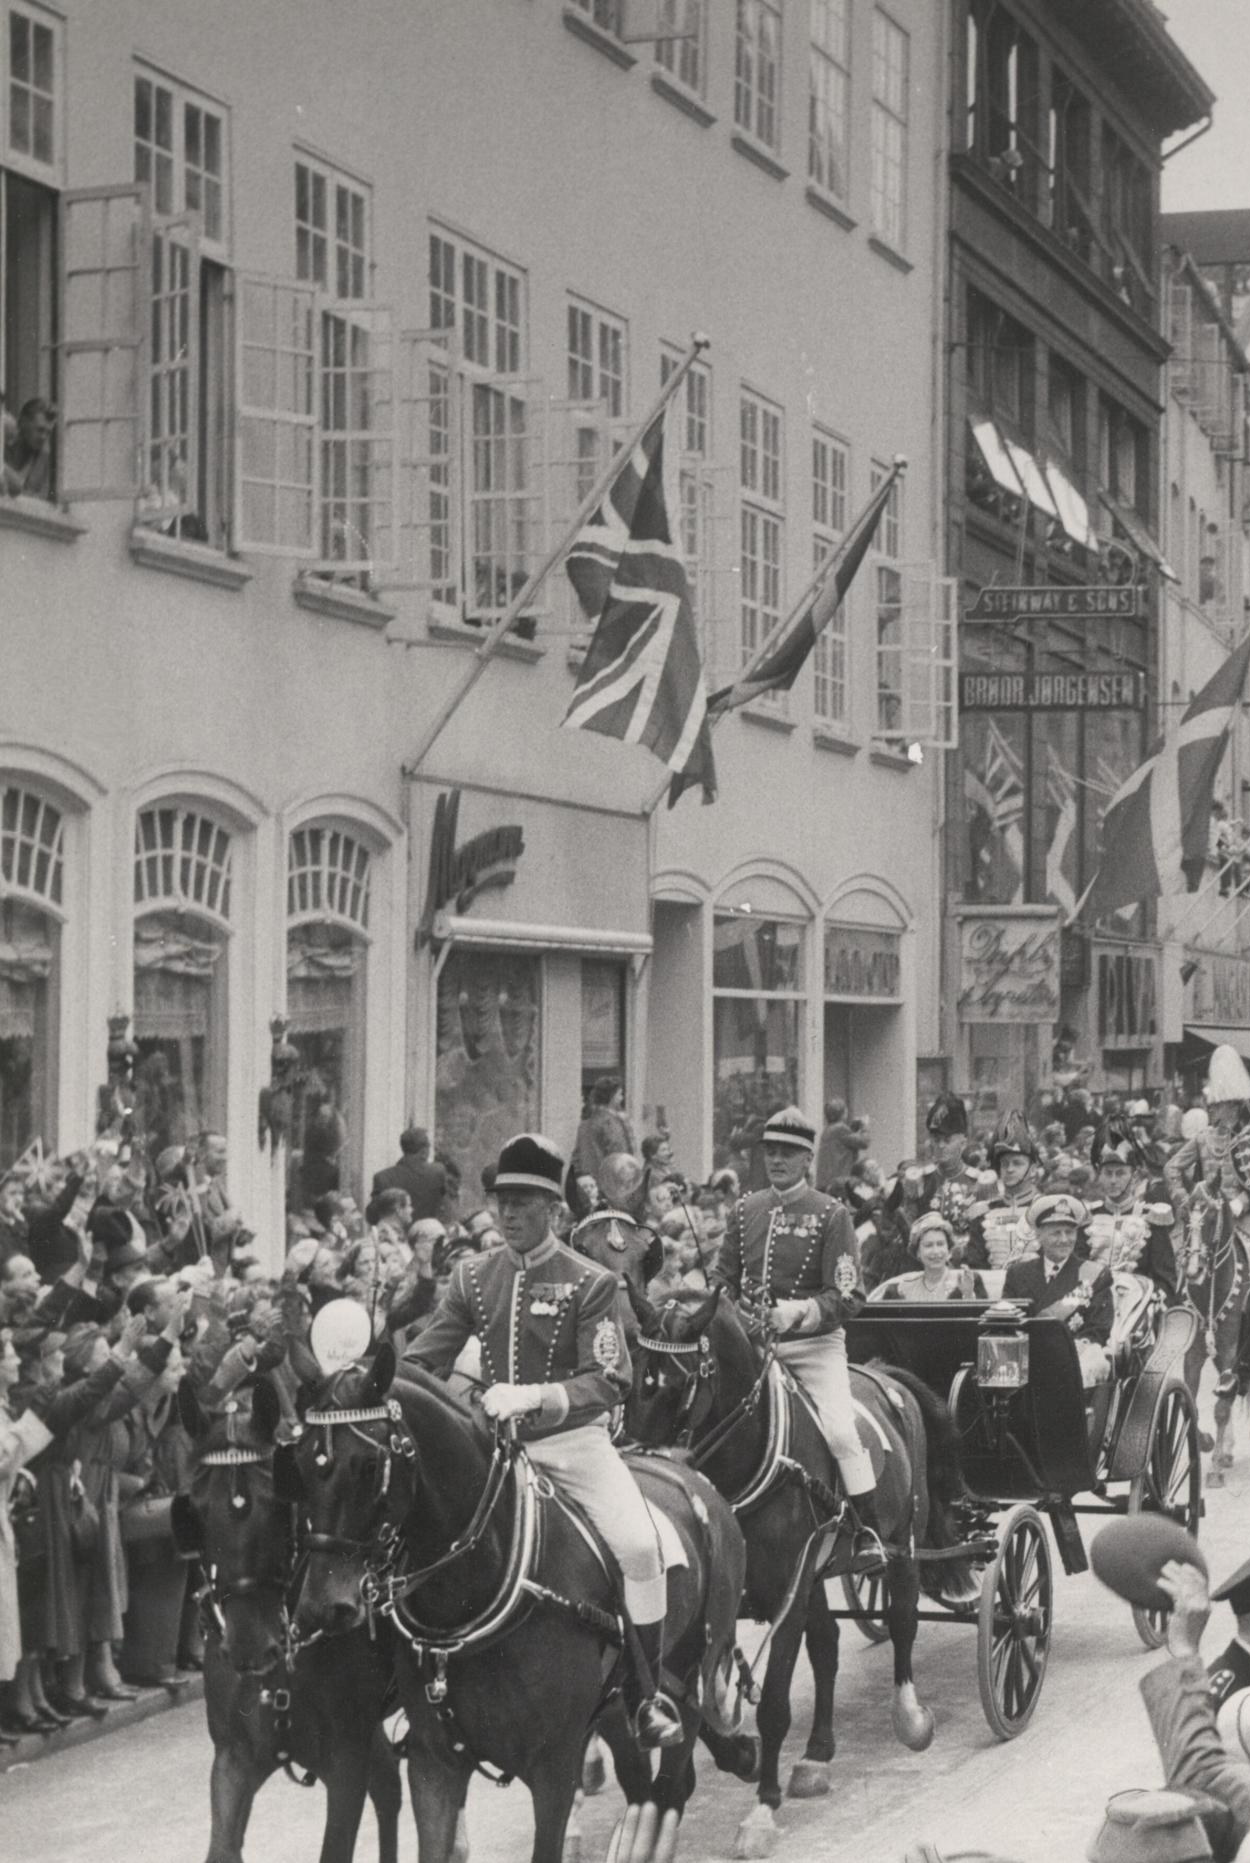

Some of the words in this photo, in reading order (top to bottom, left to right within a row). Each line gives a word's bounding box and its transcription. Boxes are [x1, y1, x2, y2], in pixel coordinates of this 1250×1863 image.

[983, 590, 1061, 613] STEINWAY
[1085, 589, 1130, 612] SONS
[1028, 674, 1135, 706] JØRGENSEN
